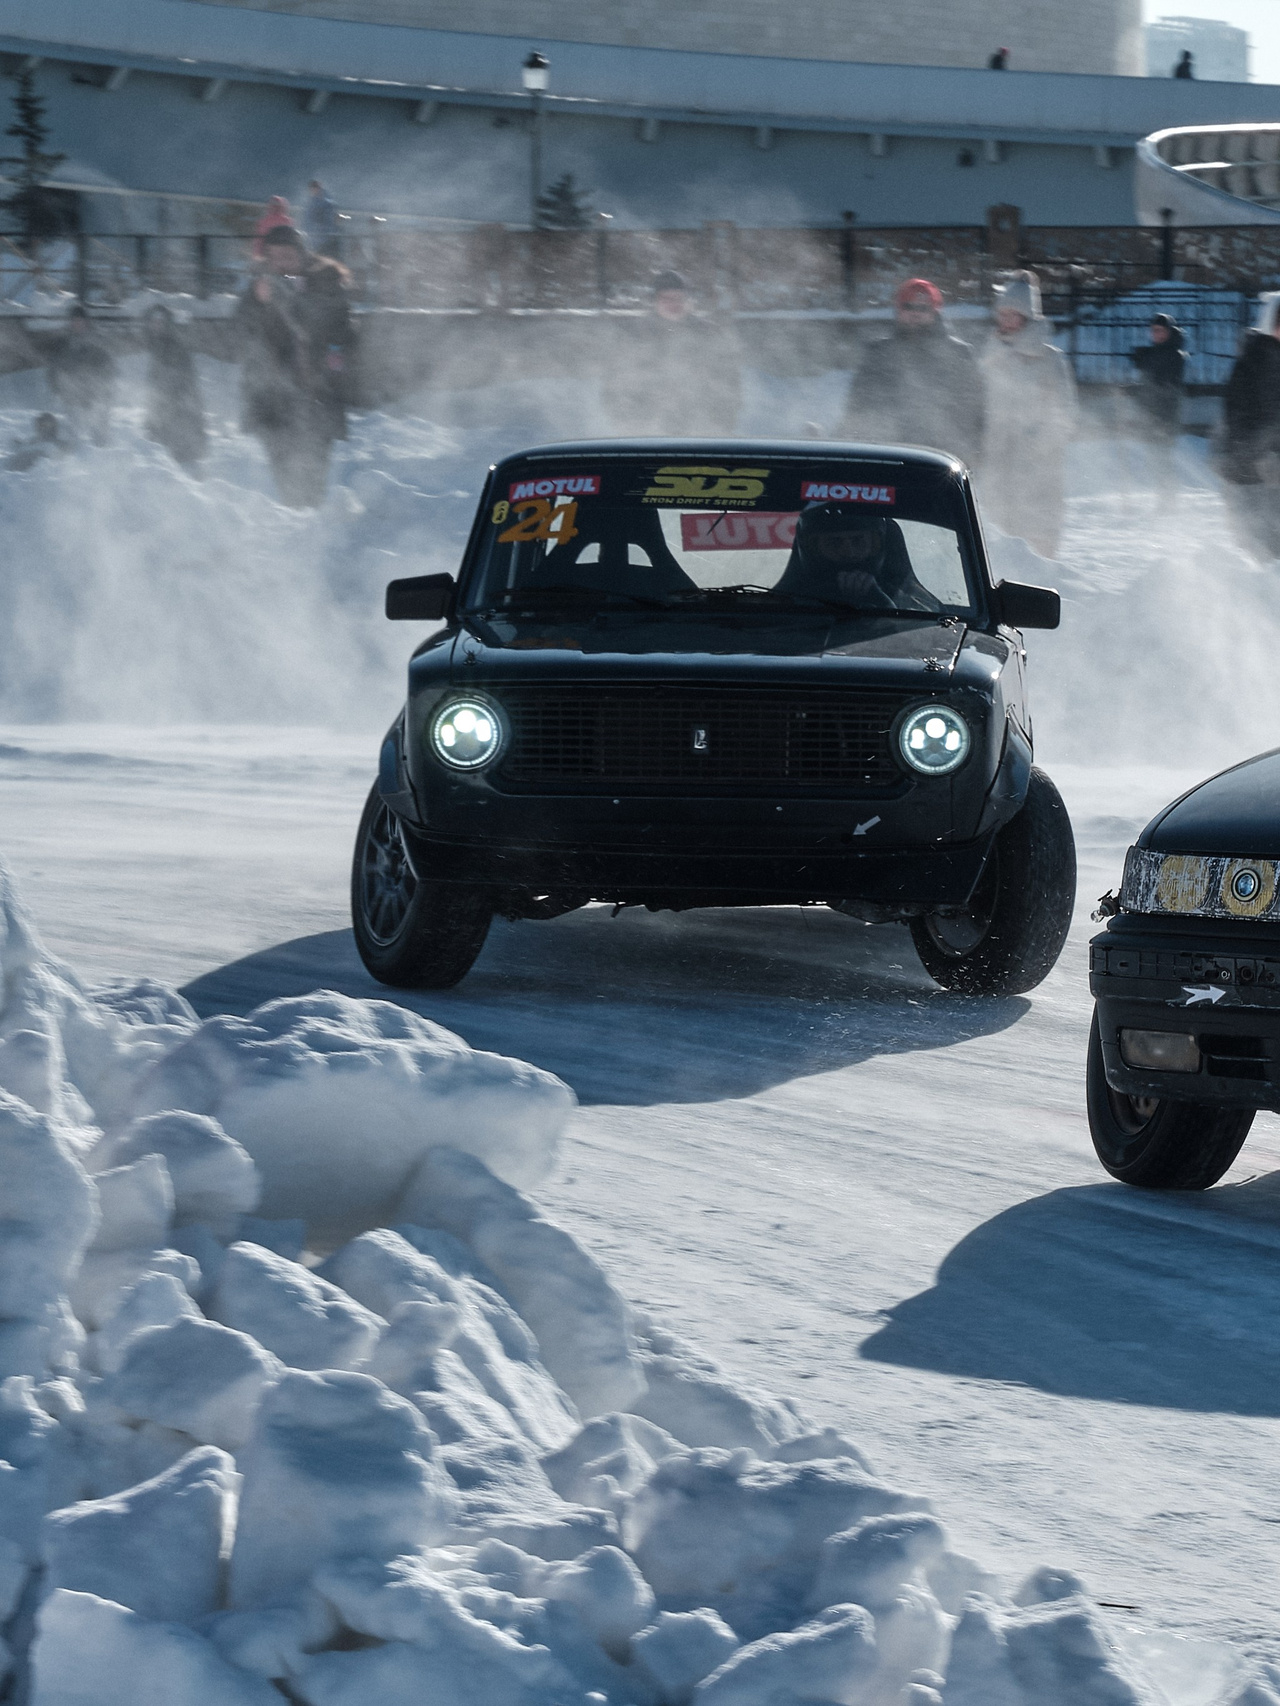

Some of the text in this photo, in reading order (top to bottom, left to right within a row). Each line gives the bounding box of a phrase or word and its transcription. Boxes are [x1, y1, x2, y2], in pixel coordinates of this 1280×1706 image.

[513, 477, 596, 500] MOTUL
[805, 483, 891, 502] MOTUL
[498, 499, 579, 545] 24
